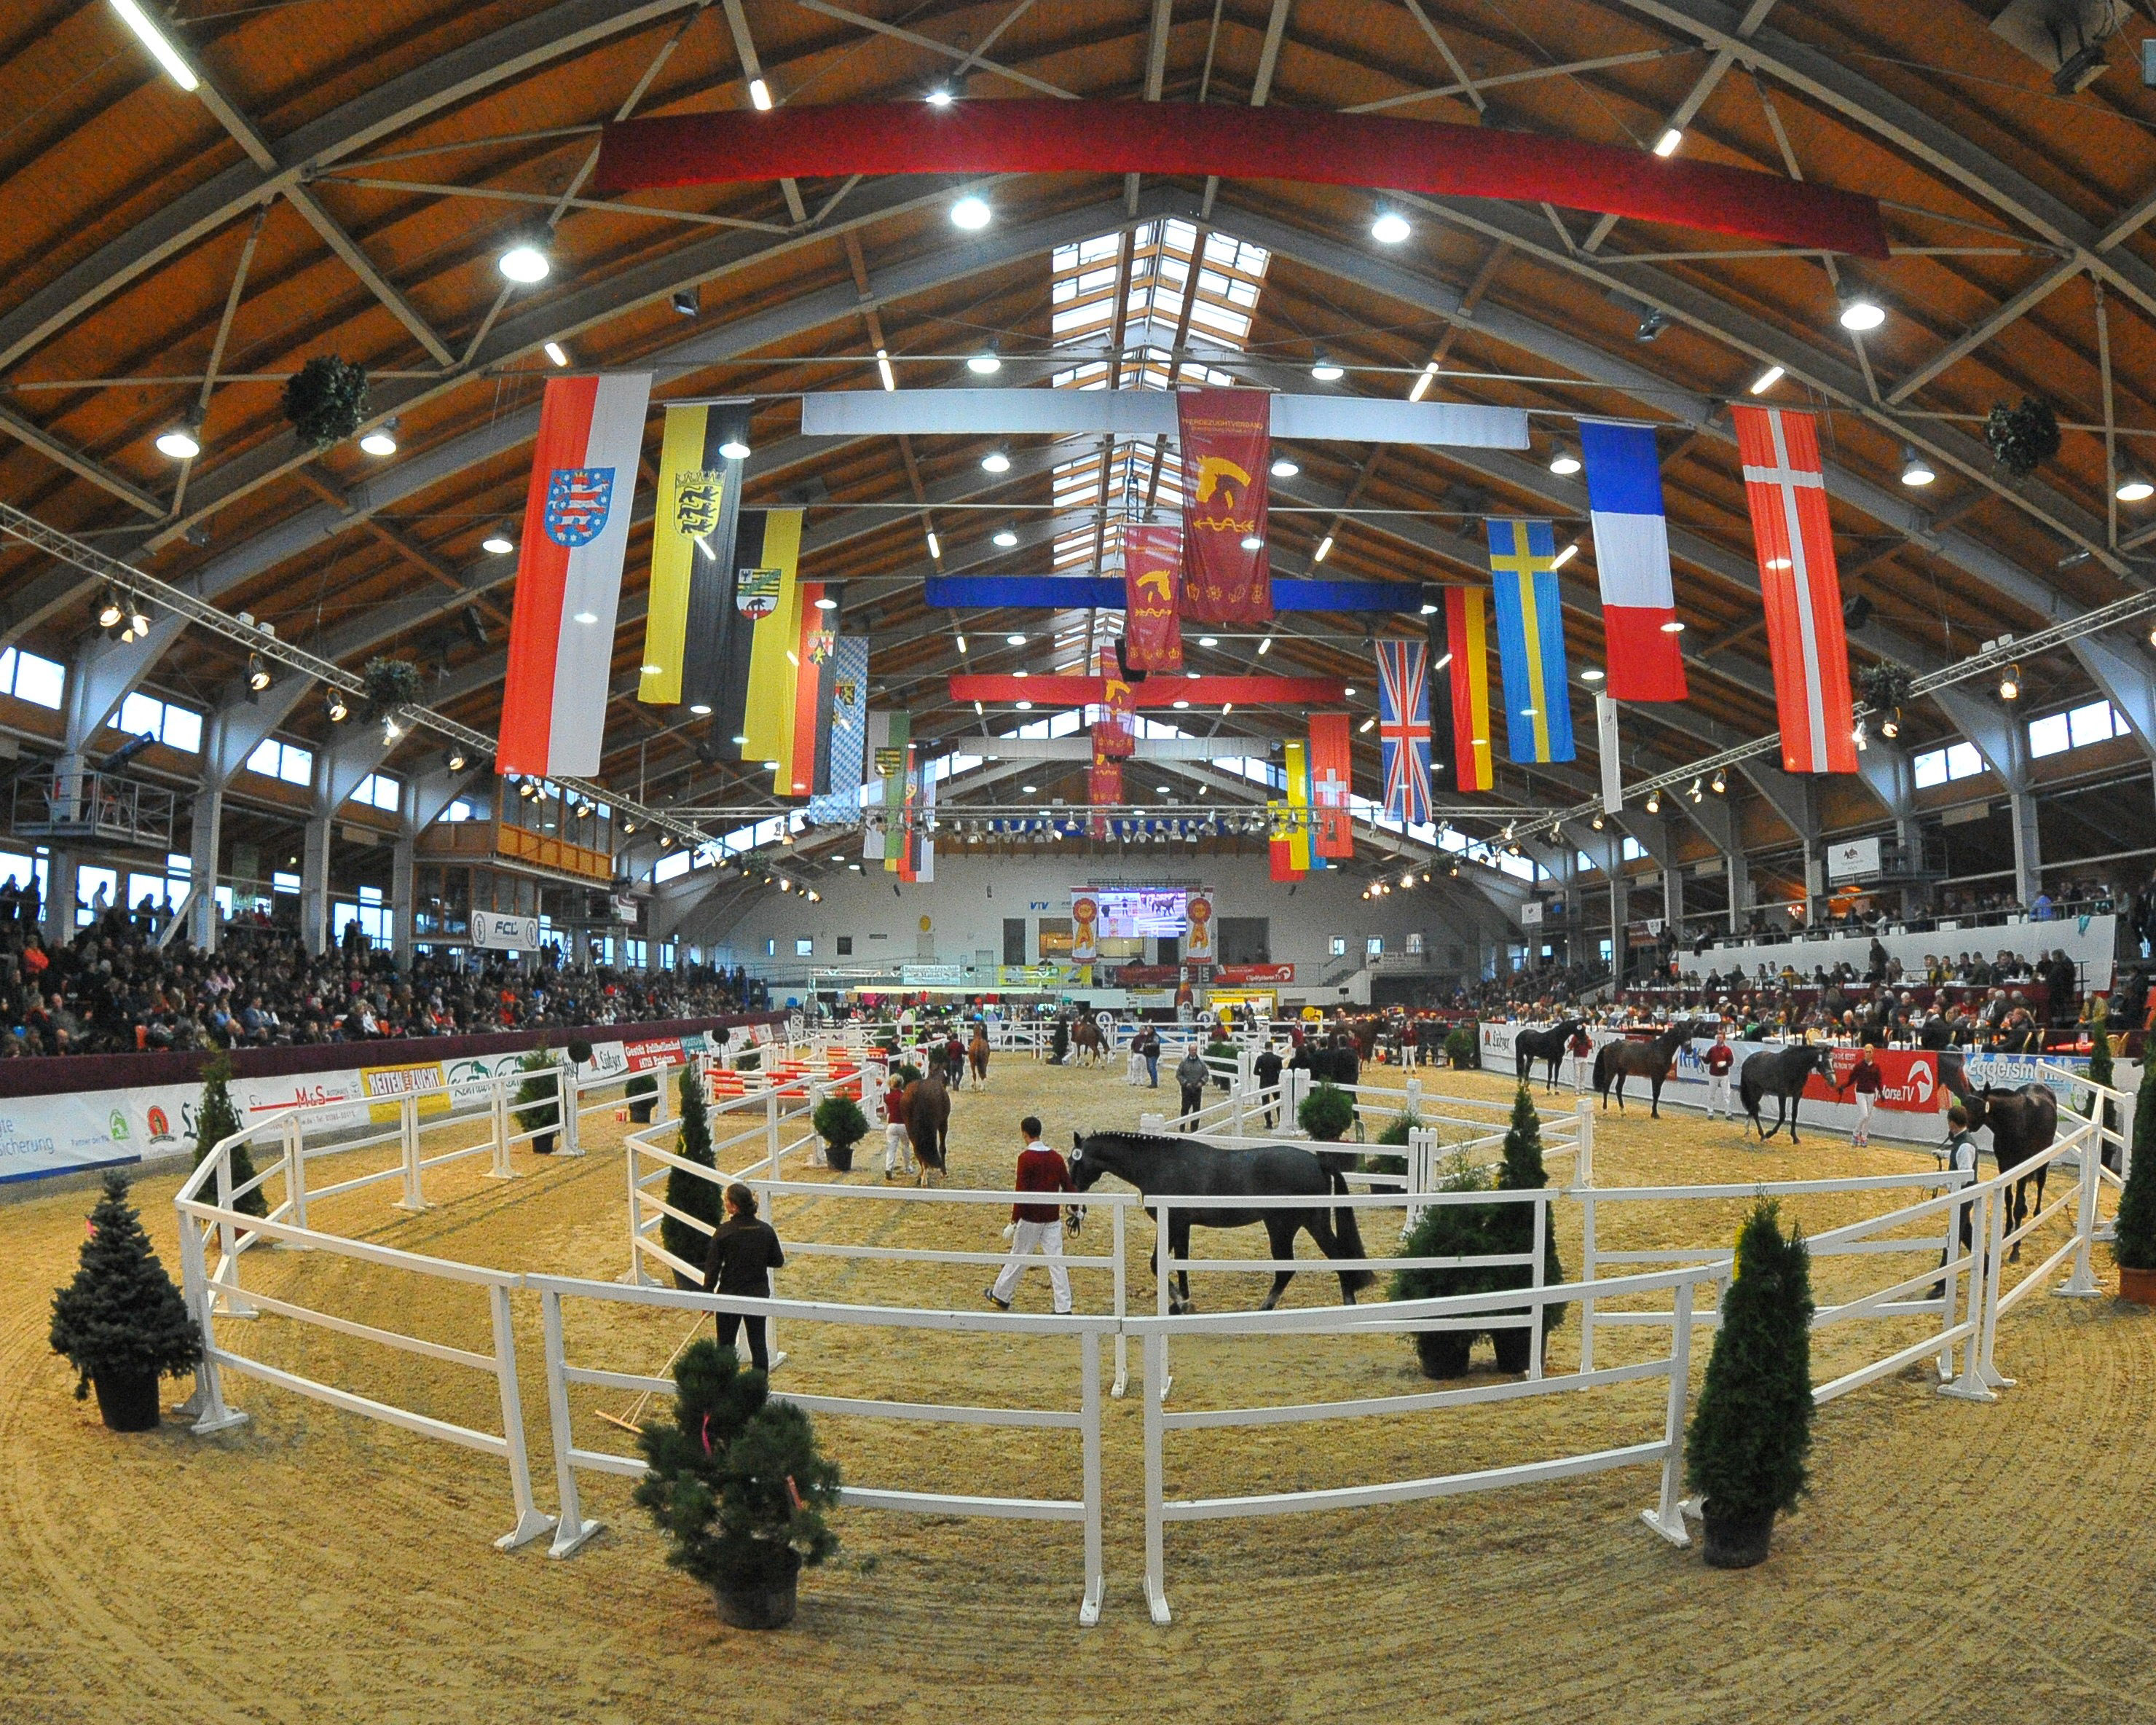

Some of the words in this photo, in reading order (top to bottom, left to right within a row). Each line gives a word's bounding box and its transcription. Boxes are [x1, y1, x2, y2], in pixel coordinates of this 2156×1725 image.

[1030, 901, 1049, 909] VTV
[368, 1071, 406, 1096] REITEN
[409, 1067, 441, 1091] ZUCHT
